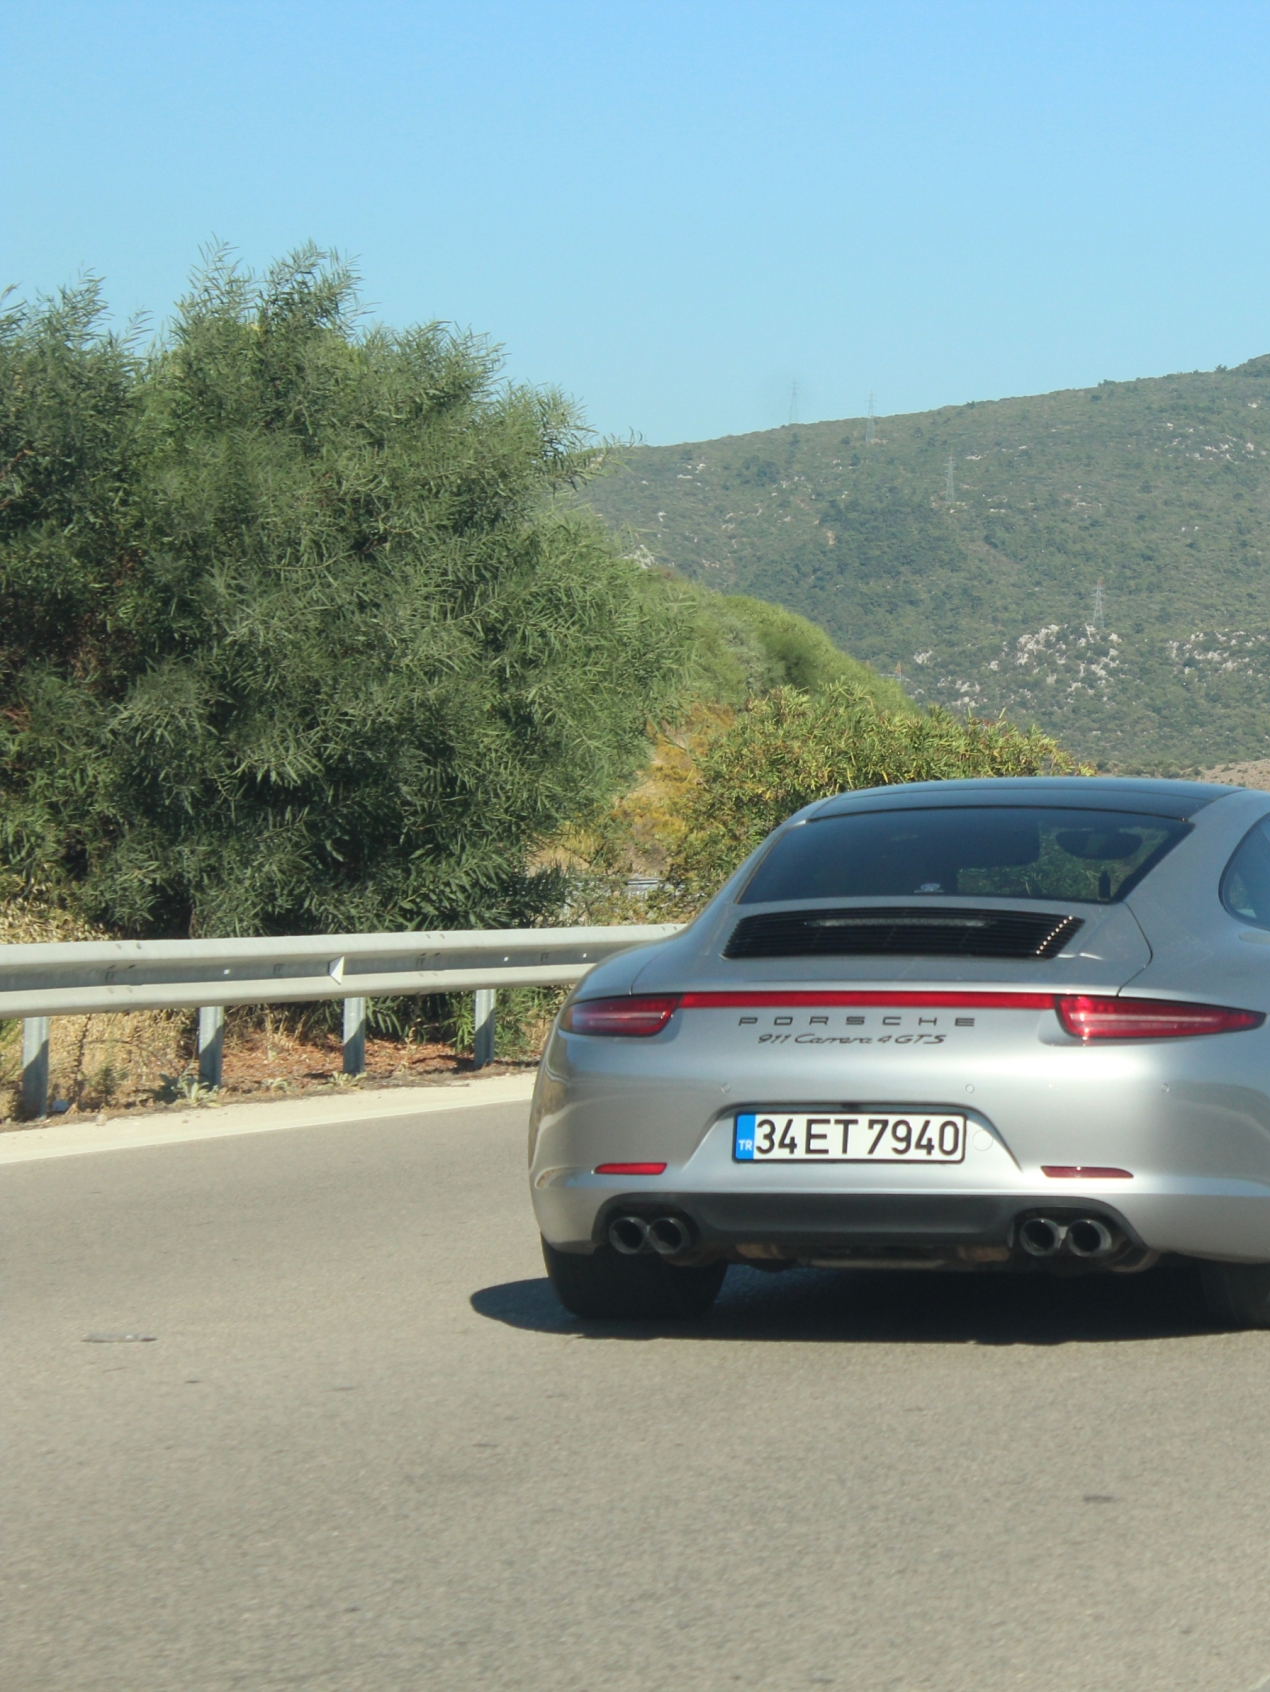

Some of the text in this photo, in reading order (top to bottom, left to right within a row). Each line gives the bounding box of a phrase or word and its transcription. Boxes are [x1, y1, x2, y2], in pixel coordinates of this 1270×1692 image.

[737, 1016, 976, 1027] PORSCHE
[757, 1032, 947, 1045] 911 Carrera 4 GTS
[738, 1118, 960, 1156] TR 34 ET 7940
